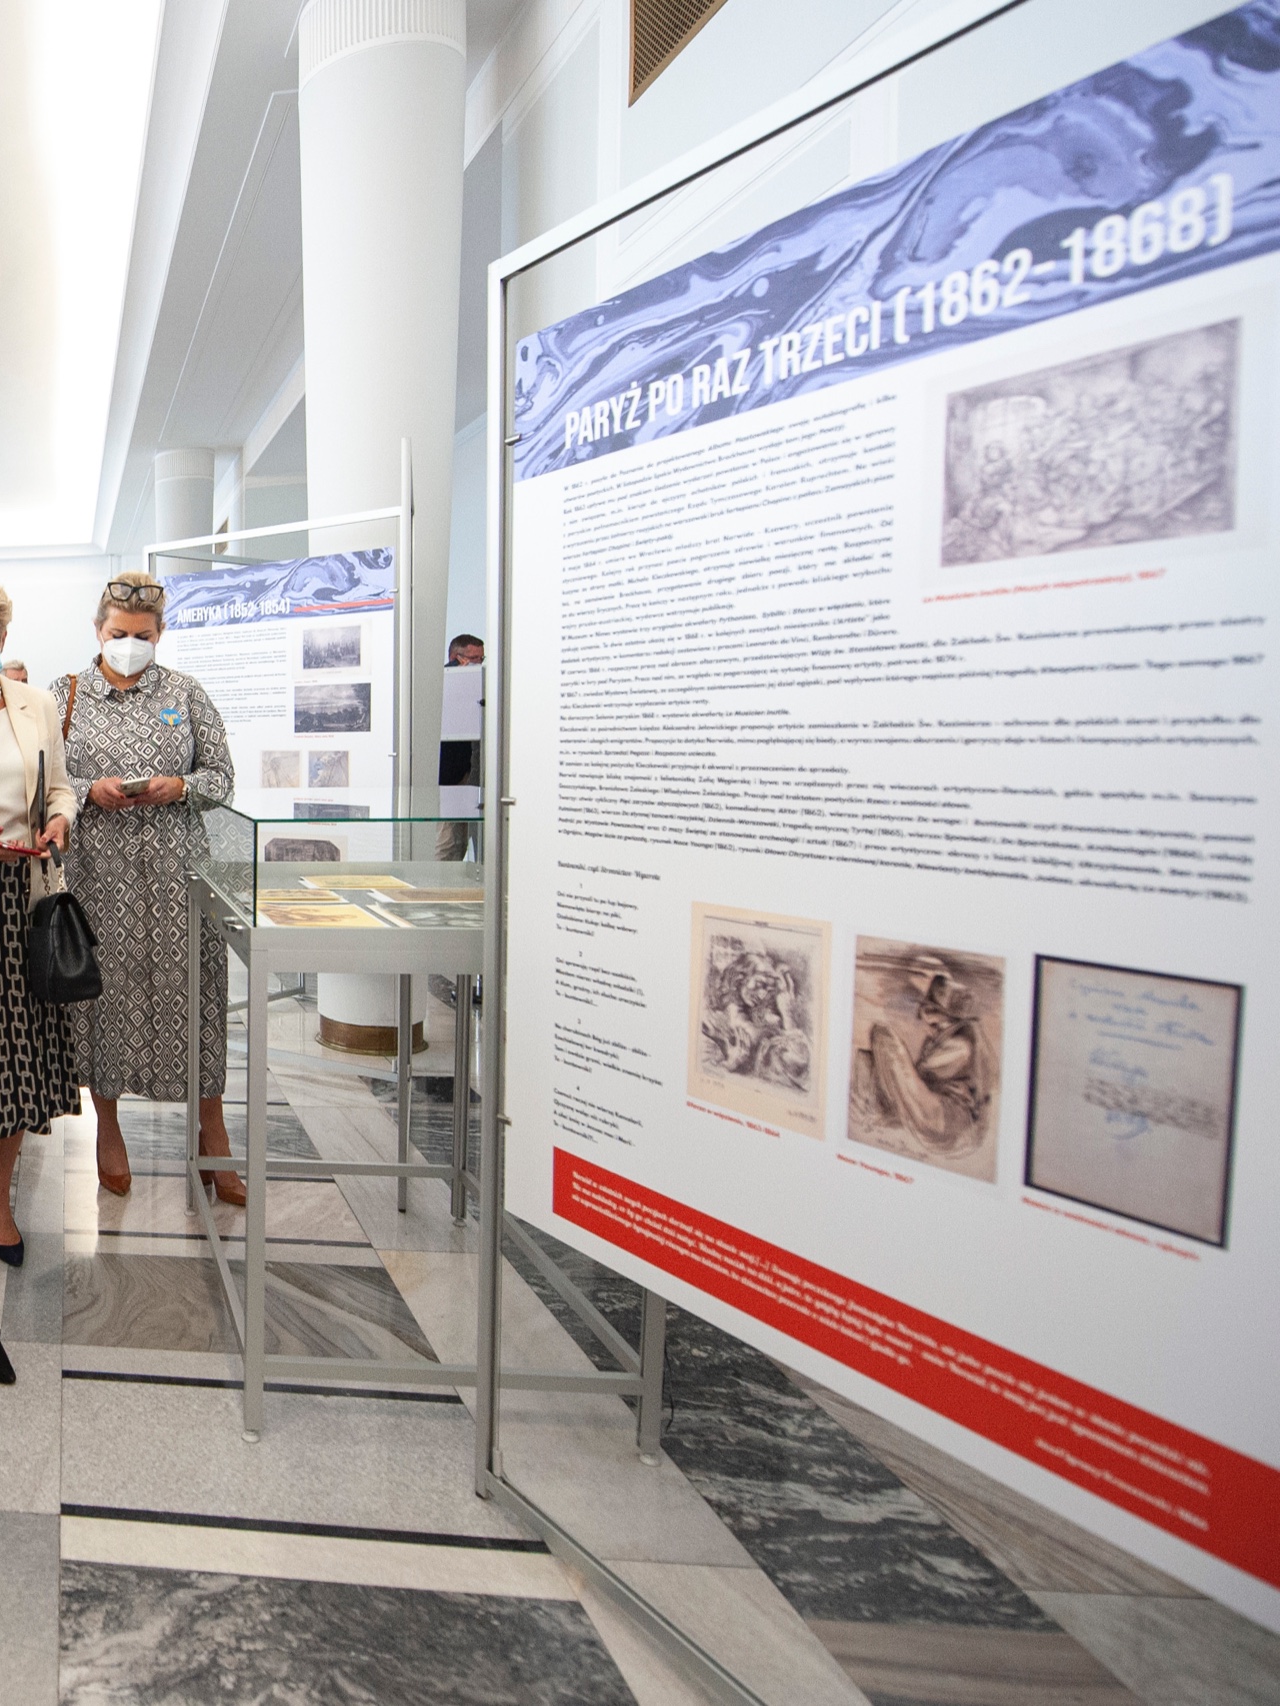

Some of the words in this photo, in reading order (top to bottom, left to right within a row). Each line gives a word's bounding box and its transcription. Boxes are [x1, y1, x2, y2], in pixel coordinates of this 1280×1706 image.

[564, 381, 642, 450] PARYŻ
[647, 373, 685, 423] PO
[691, 348, 752, 409] RAZ
[758, 301, 882, 386] TRZECI
[177, 605, 222, 624] AMERYKA
